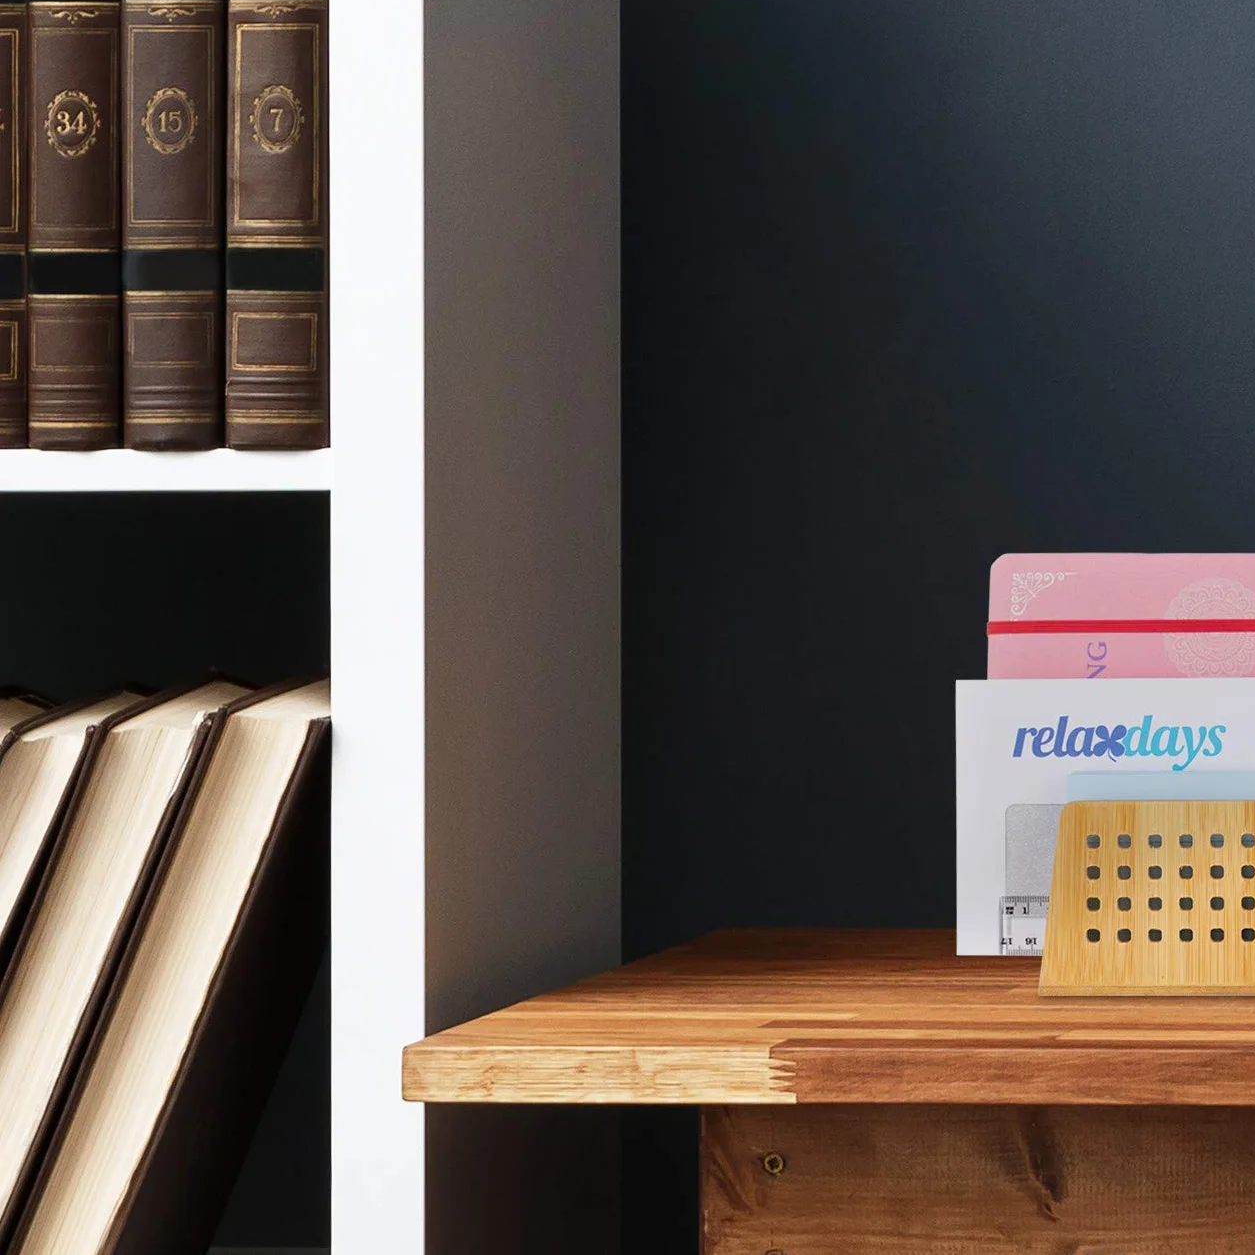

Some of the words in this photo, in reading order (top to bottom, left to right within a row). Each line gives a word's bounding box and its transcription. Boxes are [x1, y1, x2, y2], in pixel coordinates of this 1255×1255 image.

[56, 110, 87, 134] 34
[158, 110, 183, 133] 15
[269, 108, 284, 132] 7
[1012, 715, 1227, 771] relaxdays
[1025, 937, 1037, 945] 16
